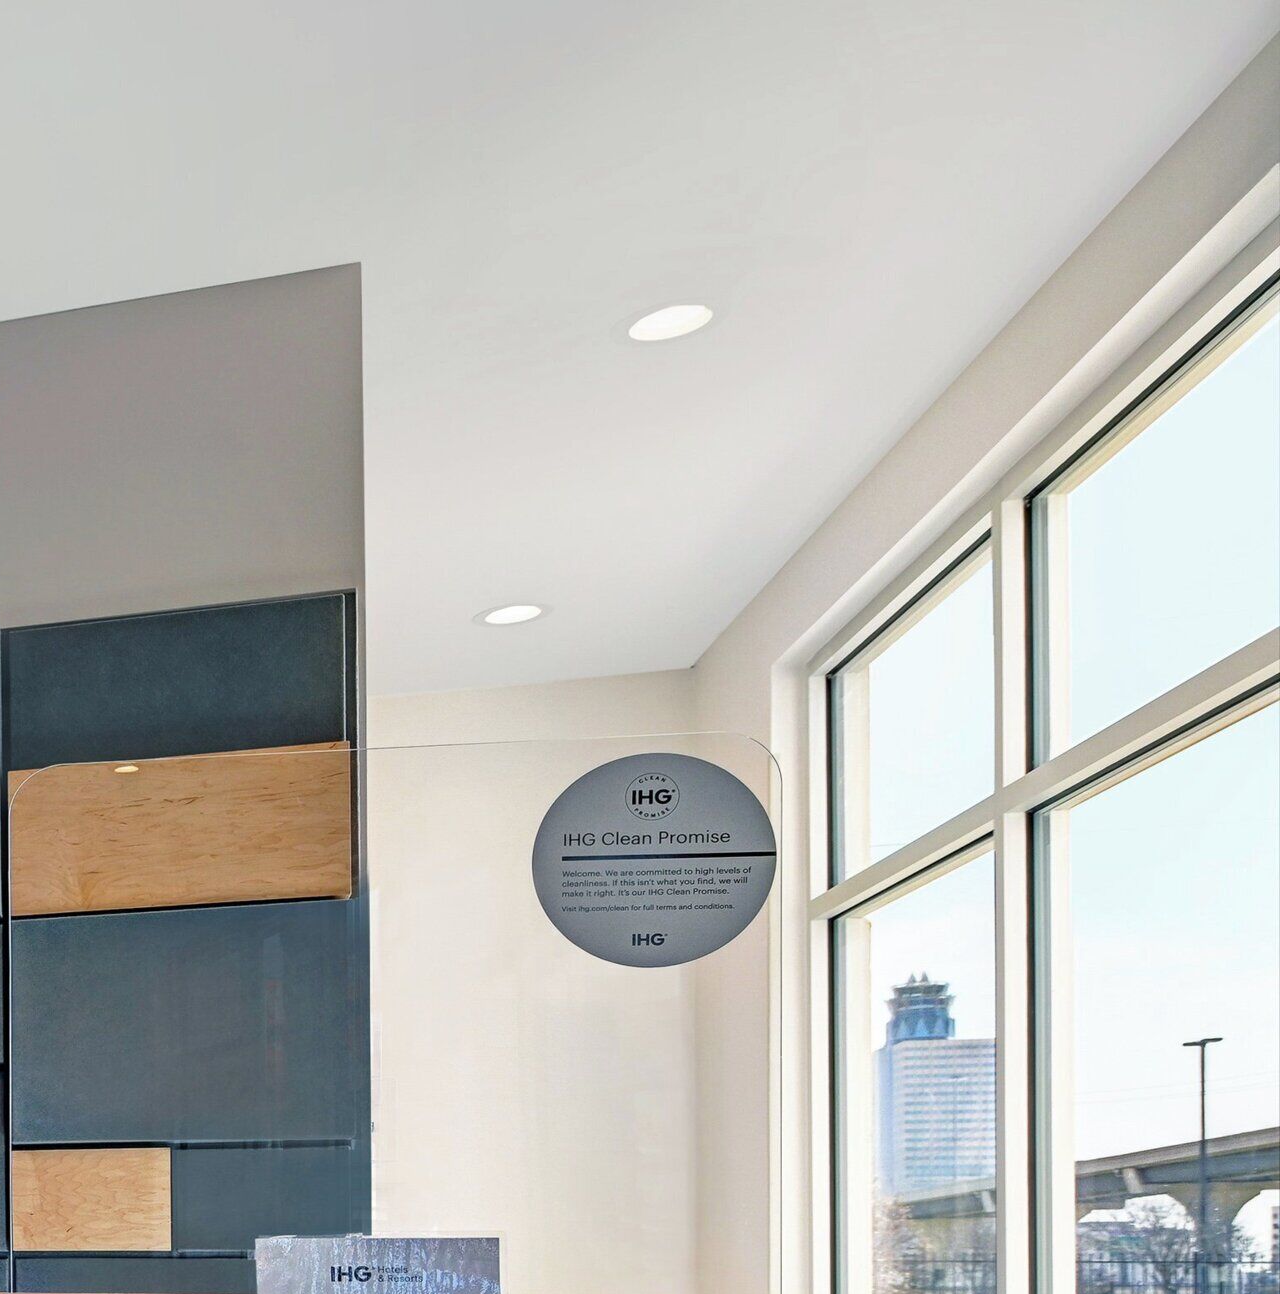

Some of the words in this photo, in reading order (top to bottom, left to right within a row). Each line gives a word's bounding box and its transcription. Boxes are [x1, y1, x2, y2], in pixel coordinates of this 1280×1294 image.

[632, 789, 672, 805] IHG
[563, 833, 595, 846] IHG
[602, 832, 652, 845] Clean
[659, 830, 731, 844] Promise
[637, 868, 681, 876] committed
[695, 868, 713, 876] high
[562, 879, 609, 887] cleanliness.
[697, 877, 716, 885] find,
[594, 889, 615, 898] right.
[693, 887, 729, 895] Promise.
[632, 933, 665, 946] IHG
[331, 1266, 372, 1282] IHG
